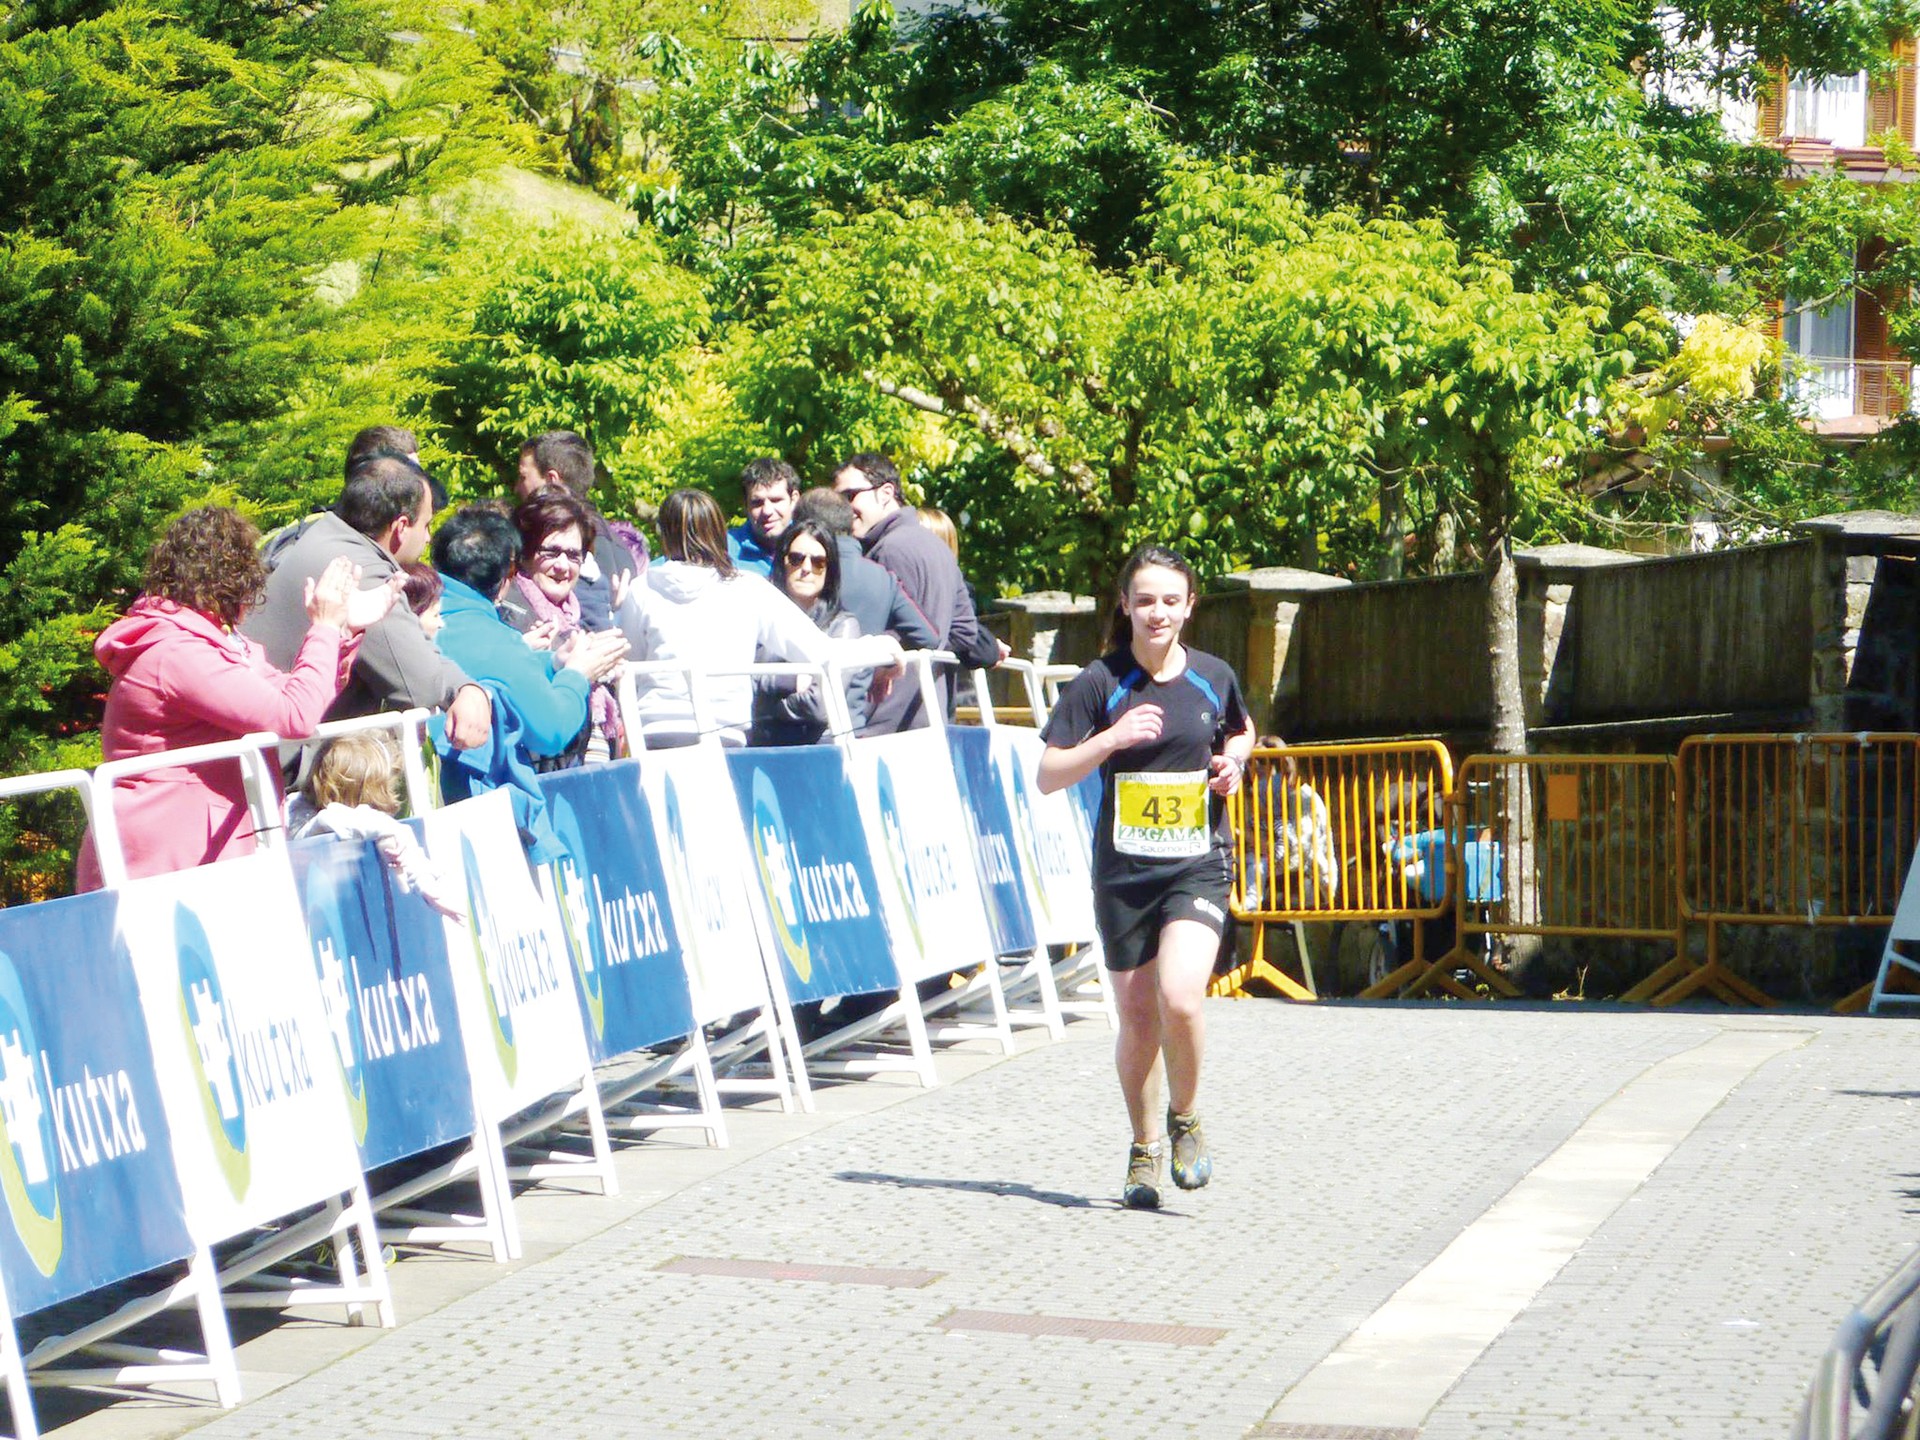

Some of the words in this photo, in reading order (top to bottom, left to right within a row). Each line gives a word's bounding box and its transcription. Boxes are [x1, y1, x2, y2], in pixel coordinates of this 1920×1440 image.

[1119, 824, 1204, 842] ZEGAMA
[1141, 795, 1183, 825] 43
[592, 873, 669, 967] kutxa
[790, 836, 870, 923] kutxa
[350, 955, 441, 1061] kutxa
[491, 913, 560, 1009] kutxa
[228, 998, 314, 1109] kutxa
[40, 1049, 147, 1173] kutxa
